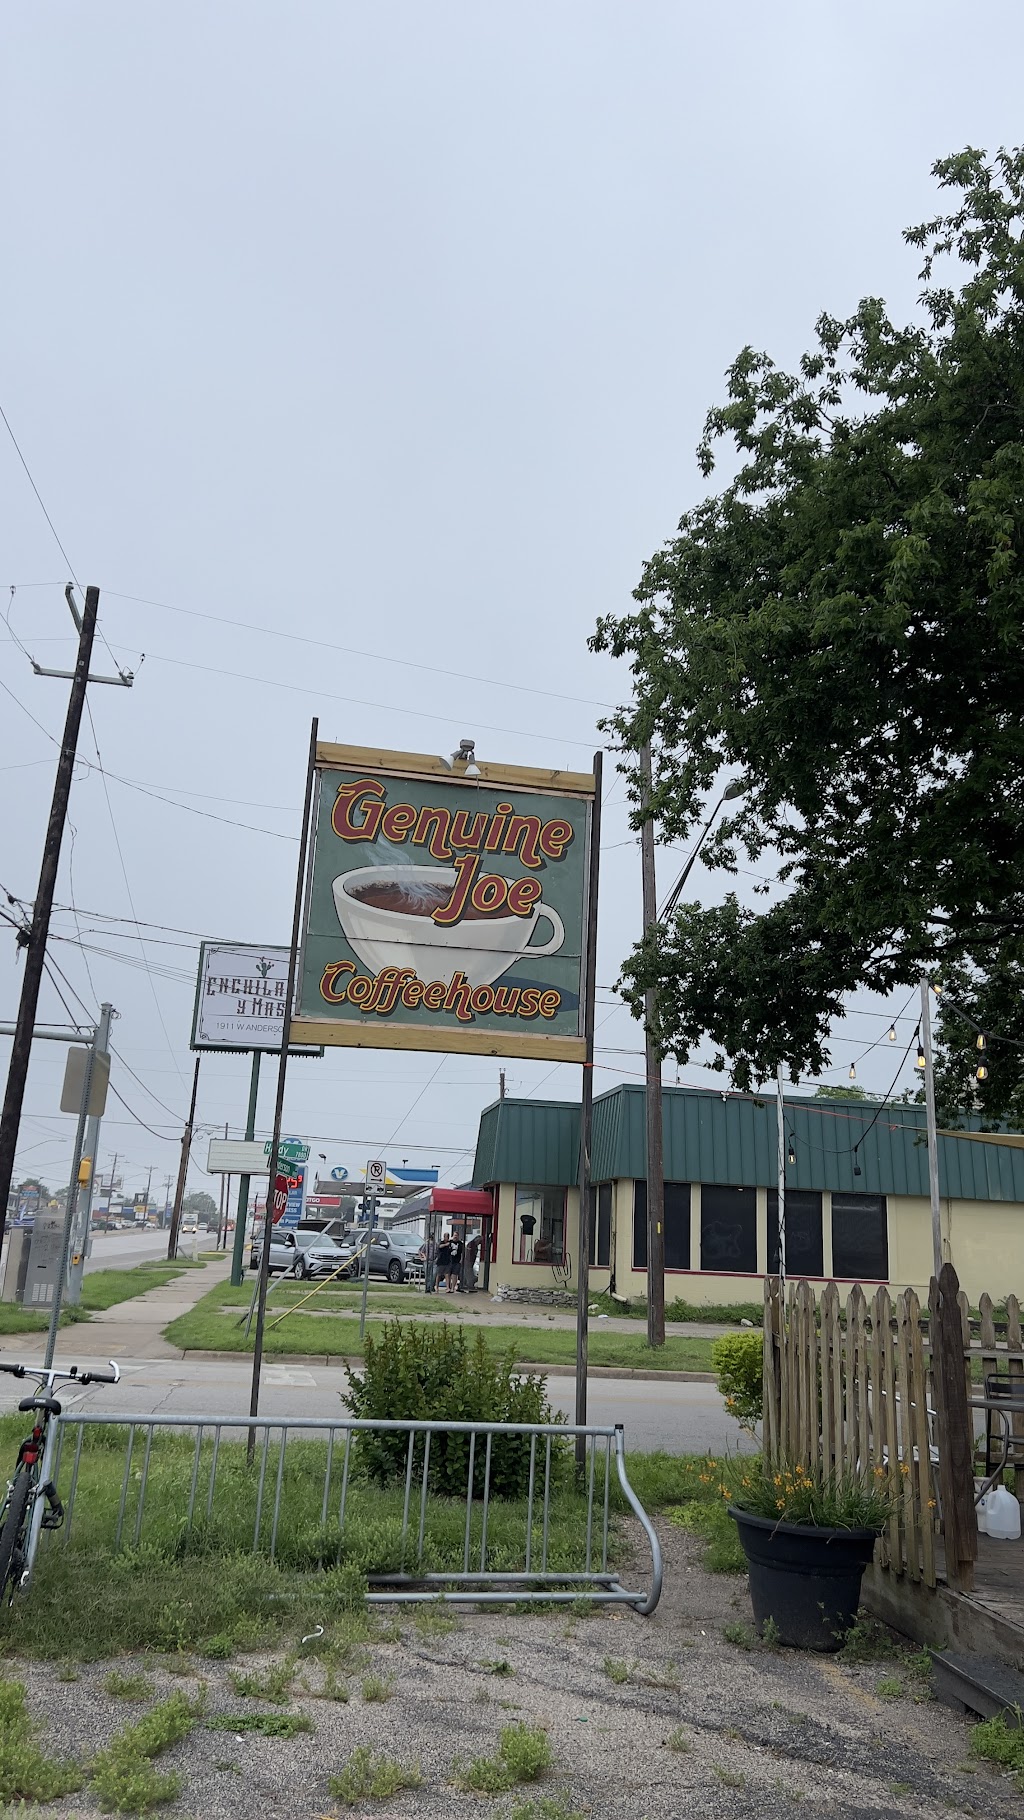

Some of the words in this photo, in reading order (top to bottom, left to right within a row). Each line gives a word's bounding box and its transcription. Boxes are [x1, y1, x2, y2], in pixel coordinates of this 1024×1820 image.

[331, 778, 574, 868] Genuine
[431, 853, 543, 924] Joe
[206, 976, 286, 997] ENCHILA
[319, 960, 562, 1020] Coffeehouse
[216, 1022, 235, 1030] 1911
[245, 1024, 284, 1033] ANDERSO
[264, 1142, 290, 1157] Hdy
[273, 1189, 288, 1211] TOP
